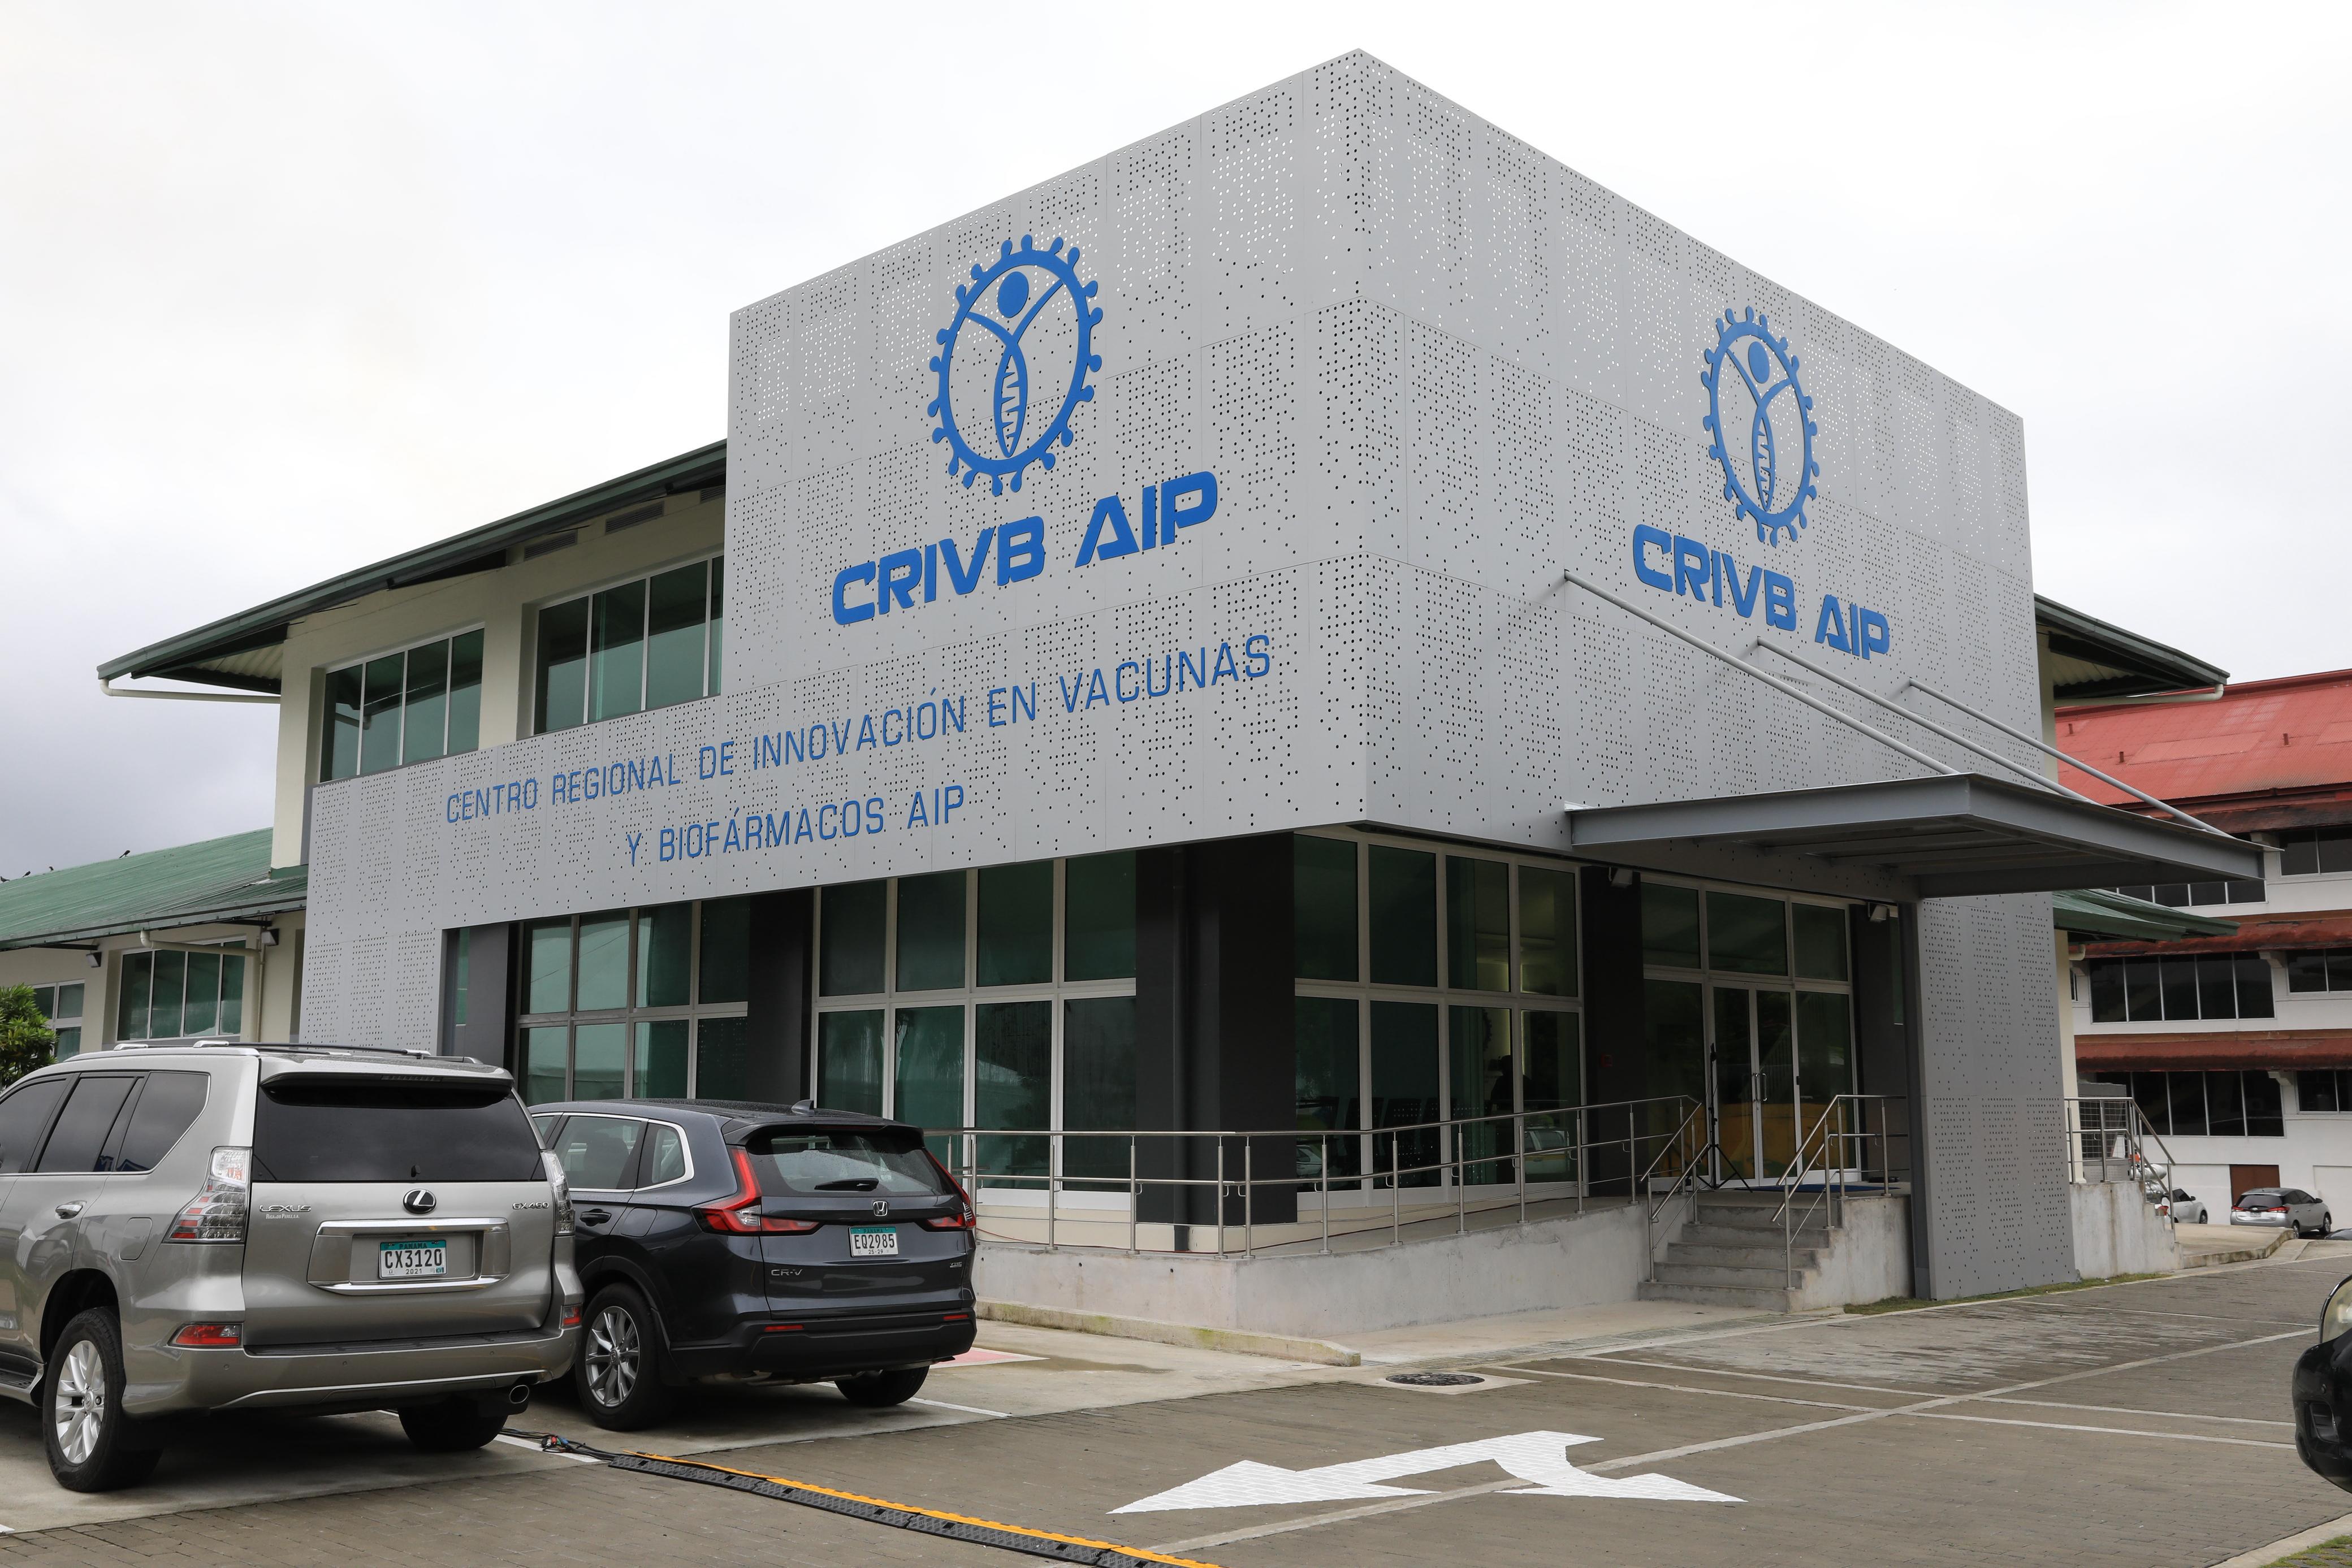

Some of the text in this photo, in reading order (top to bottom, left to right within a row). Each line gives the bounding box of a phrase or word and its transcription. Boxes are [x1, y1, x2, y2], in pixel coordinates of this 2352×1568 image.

[832, 471, 1218, 625] CRIVB AIP
[1632, 524, 1890, 660] CRIVB AIP
[447, 634, 1270, 823] CENTRO REGIONAL DE INNOVACIÓN EN VACUNAS
[626, 785, 964, 867] Y BIOFÁRMACOS AIP
[385, 1249, 442, 1269] CX3120
[854, 1234, 894, 1249] EQ2985
